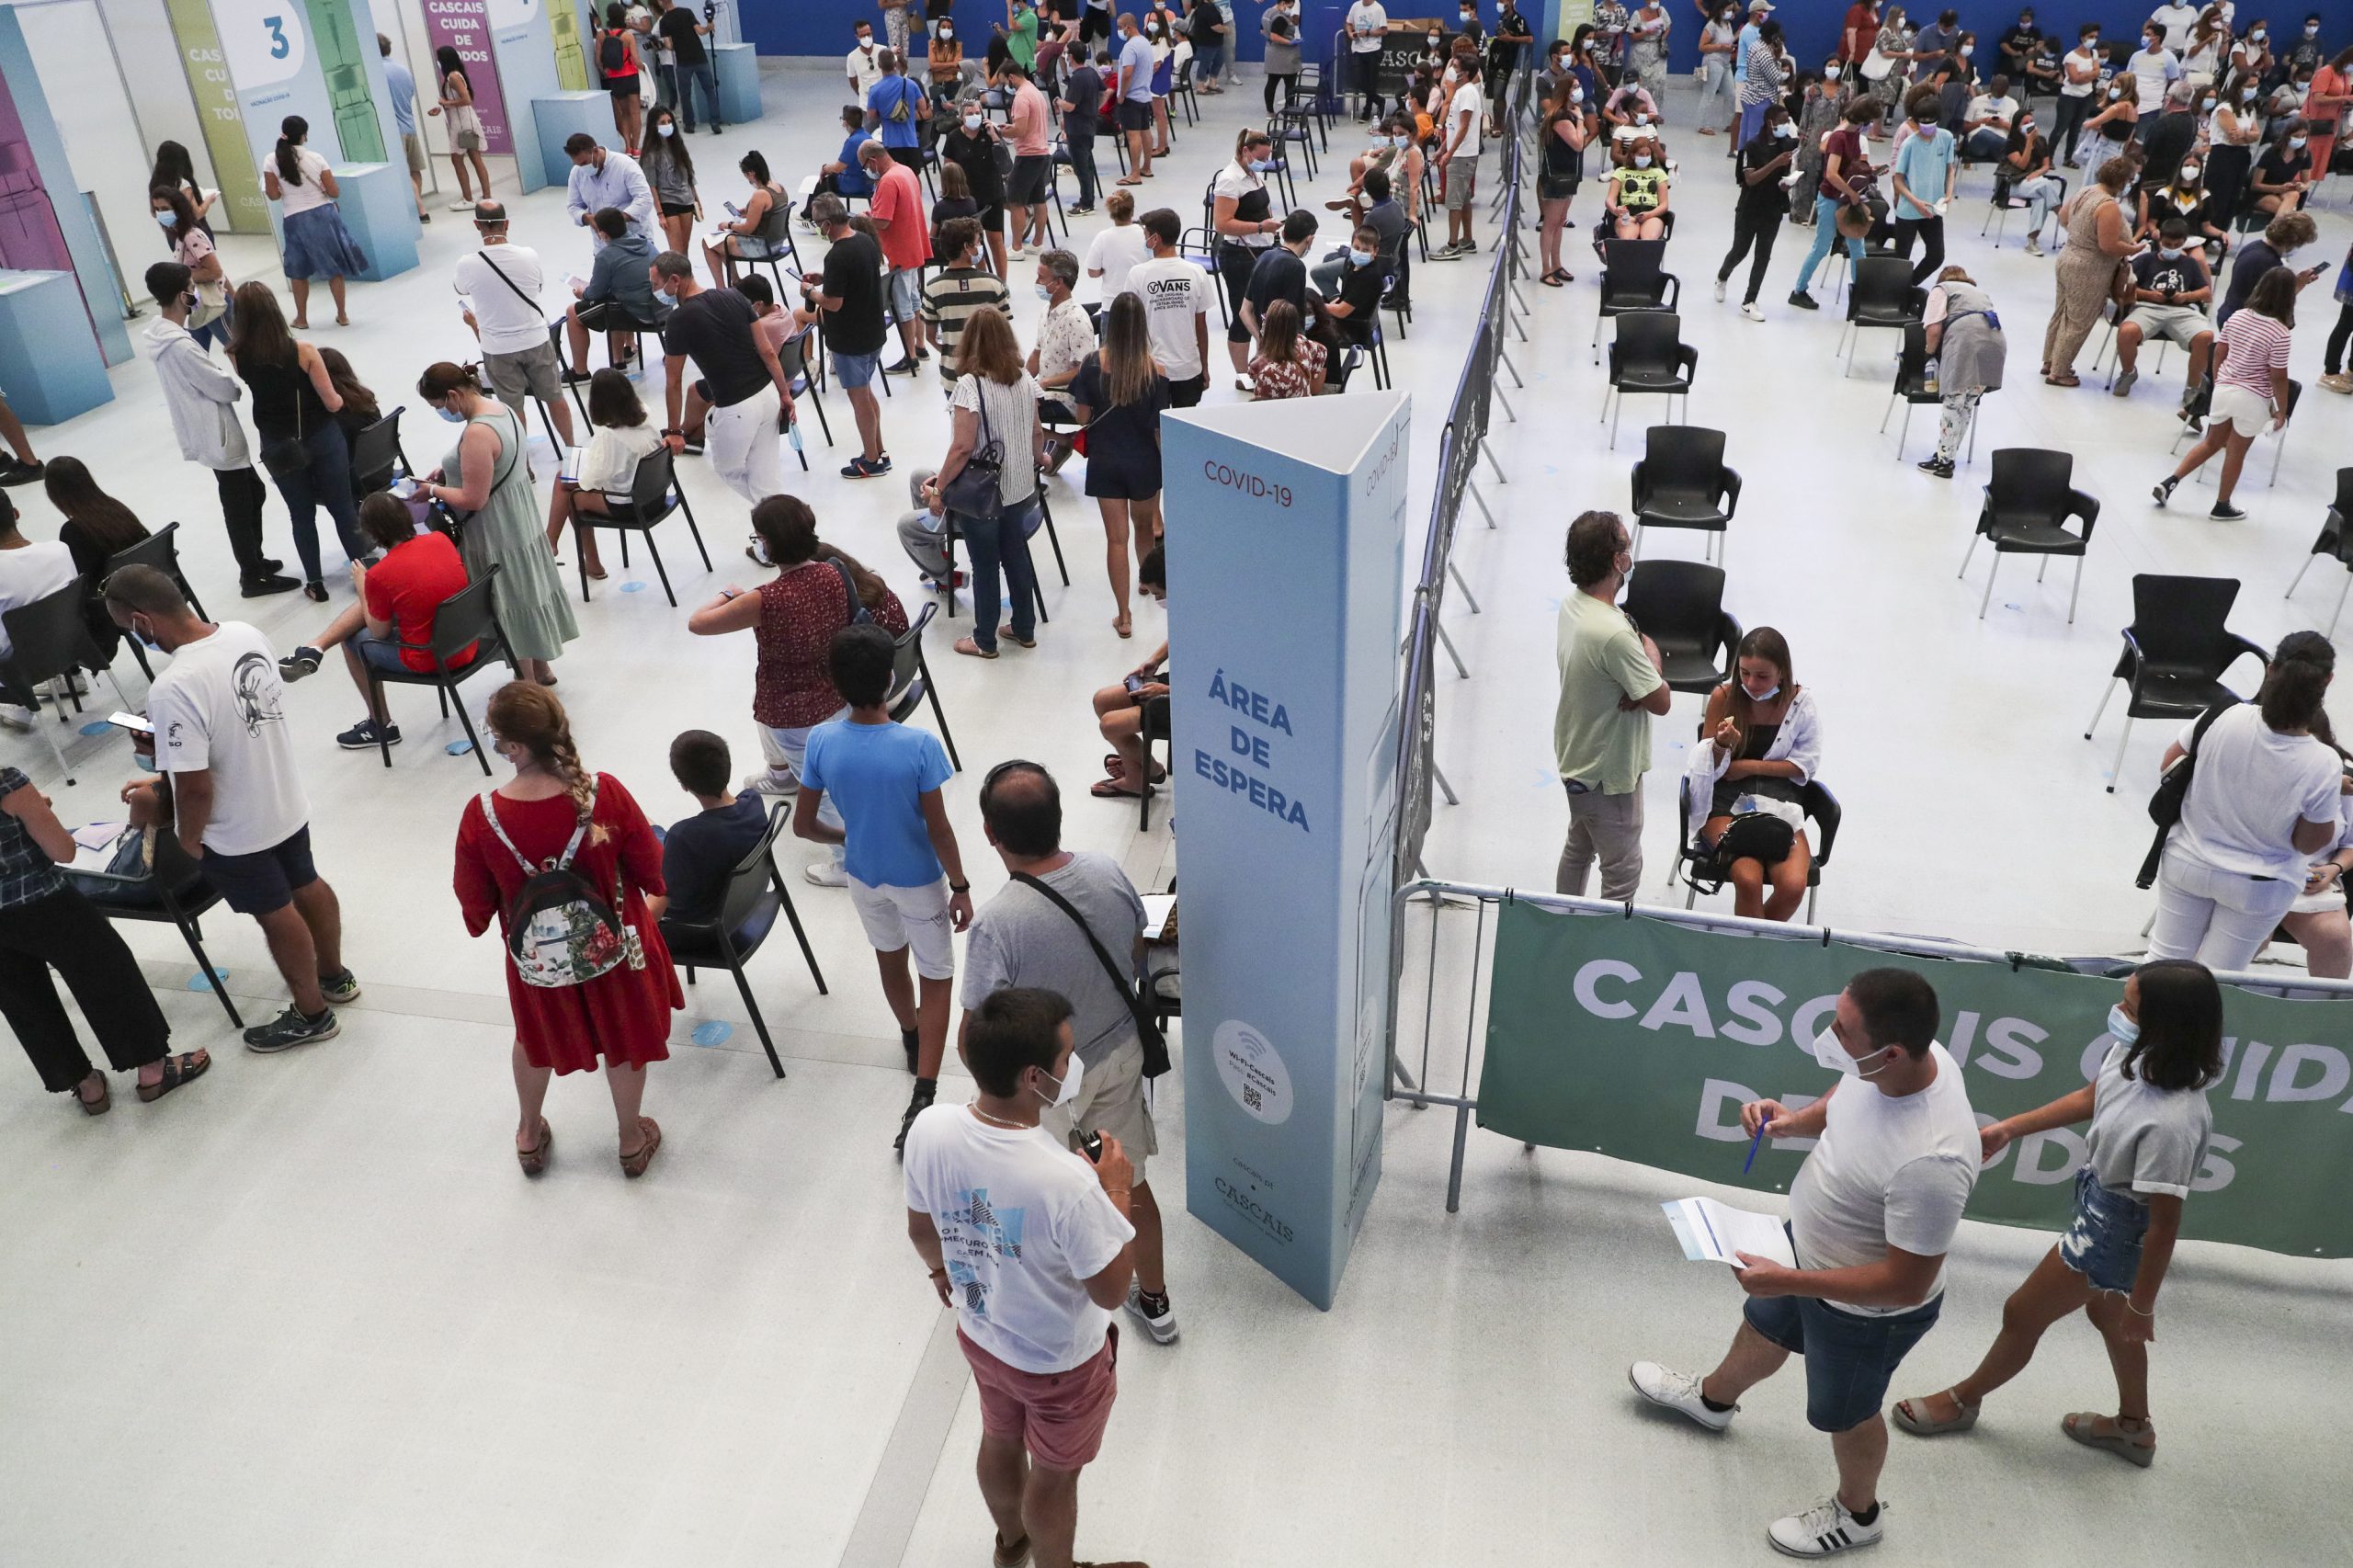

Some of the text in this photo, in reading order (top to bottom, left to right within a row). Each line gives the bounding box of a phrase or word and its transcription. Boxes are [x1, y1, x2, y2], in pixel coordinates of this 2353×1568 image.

[429, 2, 484, 13] CASCAIS
[440, 17, 480, 29] CUIDA
[263, 16, 290, 60] 3
[454, 34, 472, 46] DE
[460, 51, 489, 62] DOS
[223, 89, 235, 101] D
[482, 125, 502, 134] CAIS
[1158, 278, 1191, 292] VANS
[1205, 460, 1292, 507] COVID-19
[1208, 667, 1293, 737] ÁREA
[1231, 725, 1270, 770] DE
[1195, 748, 1310, 833] ESPERA
[1574, 959, 2050, 1080] CASCIS
[1214, 1177, 1293, 1243] CASCAIS
